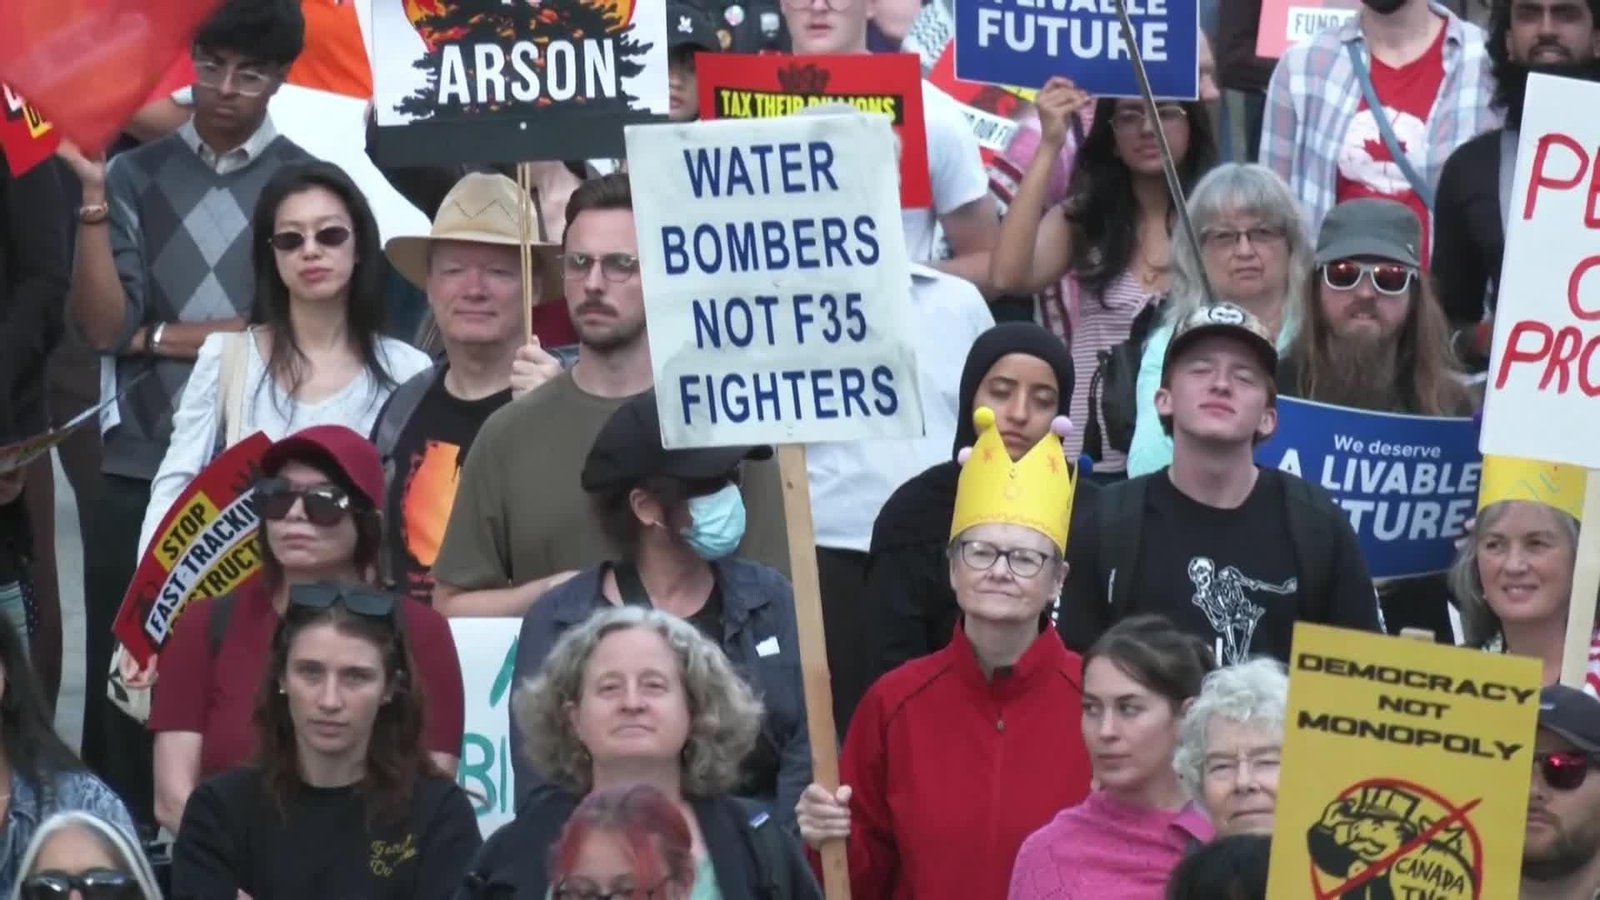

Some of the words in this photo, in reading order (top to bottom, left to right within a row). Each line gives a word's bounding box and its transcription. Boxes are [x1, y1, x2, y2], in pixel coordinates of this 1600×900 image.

[978, 8, 1168, 61] FUTURE
[438, 38, 617, 104] ARSON
[720, 90, 752, 117] TAX
[683, 141, 838, 198] WATER
[662, 215, 880, 275] BOMBERS
[692, 296, 779, 349] NOT
[793, 293, 867, 344] F35
[679, 365, 899, 425] FIGHTERS
[1278, 448, 1302, 478] A
[1321, 455, 1482, 495] LIVABLE
[1334, 434, 1364, 454] We
[1368, 440, 1441, 459] deserve
[162, 502, 206, 560] STOP
[1298, 653, 1536, 704] DEMOCRACY
[1378, 695, 1450, 719] NOT
[1297, 711, 1524, 761] MONOPOLY
[1395, 858, 1464, 894] CANADA
